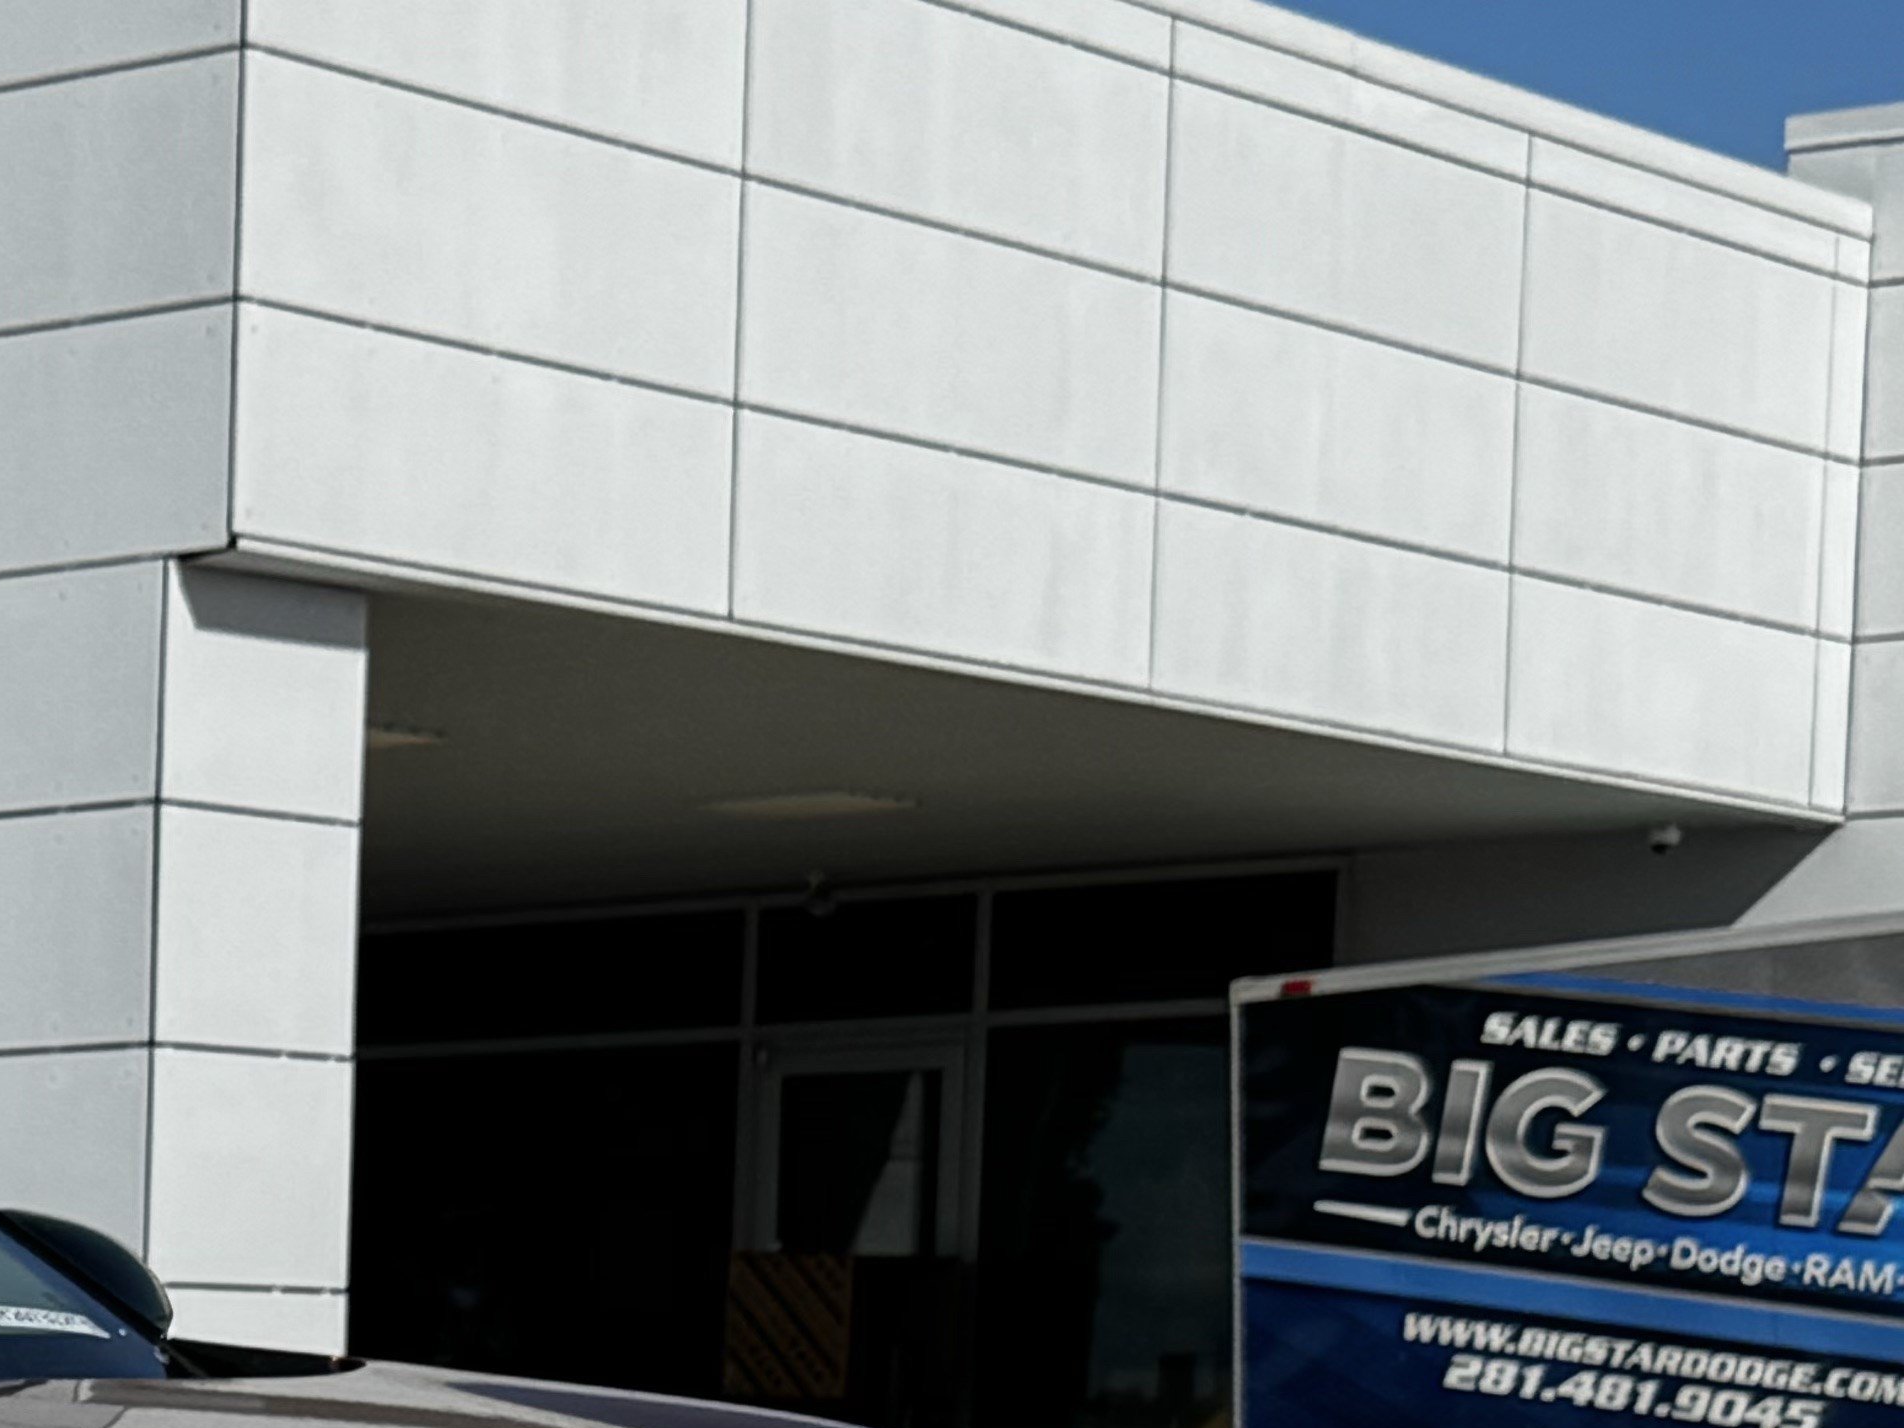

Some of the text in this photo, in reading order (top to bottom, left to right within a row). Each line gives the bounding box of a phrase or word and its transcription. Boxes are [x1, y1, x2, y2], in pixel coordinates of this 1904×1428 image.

[1481, 1012, 1904, 1088] SALES PARTS SE
[1319, 1047, 1606, 1198] BIG
[1414, 1205, 1896, 1296] Chrysler Jeep Dodge RAM
